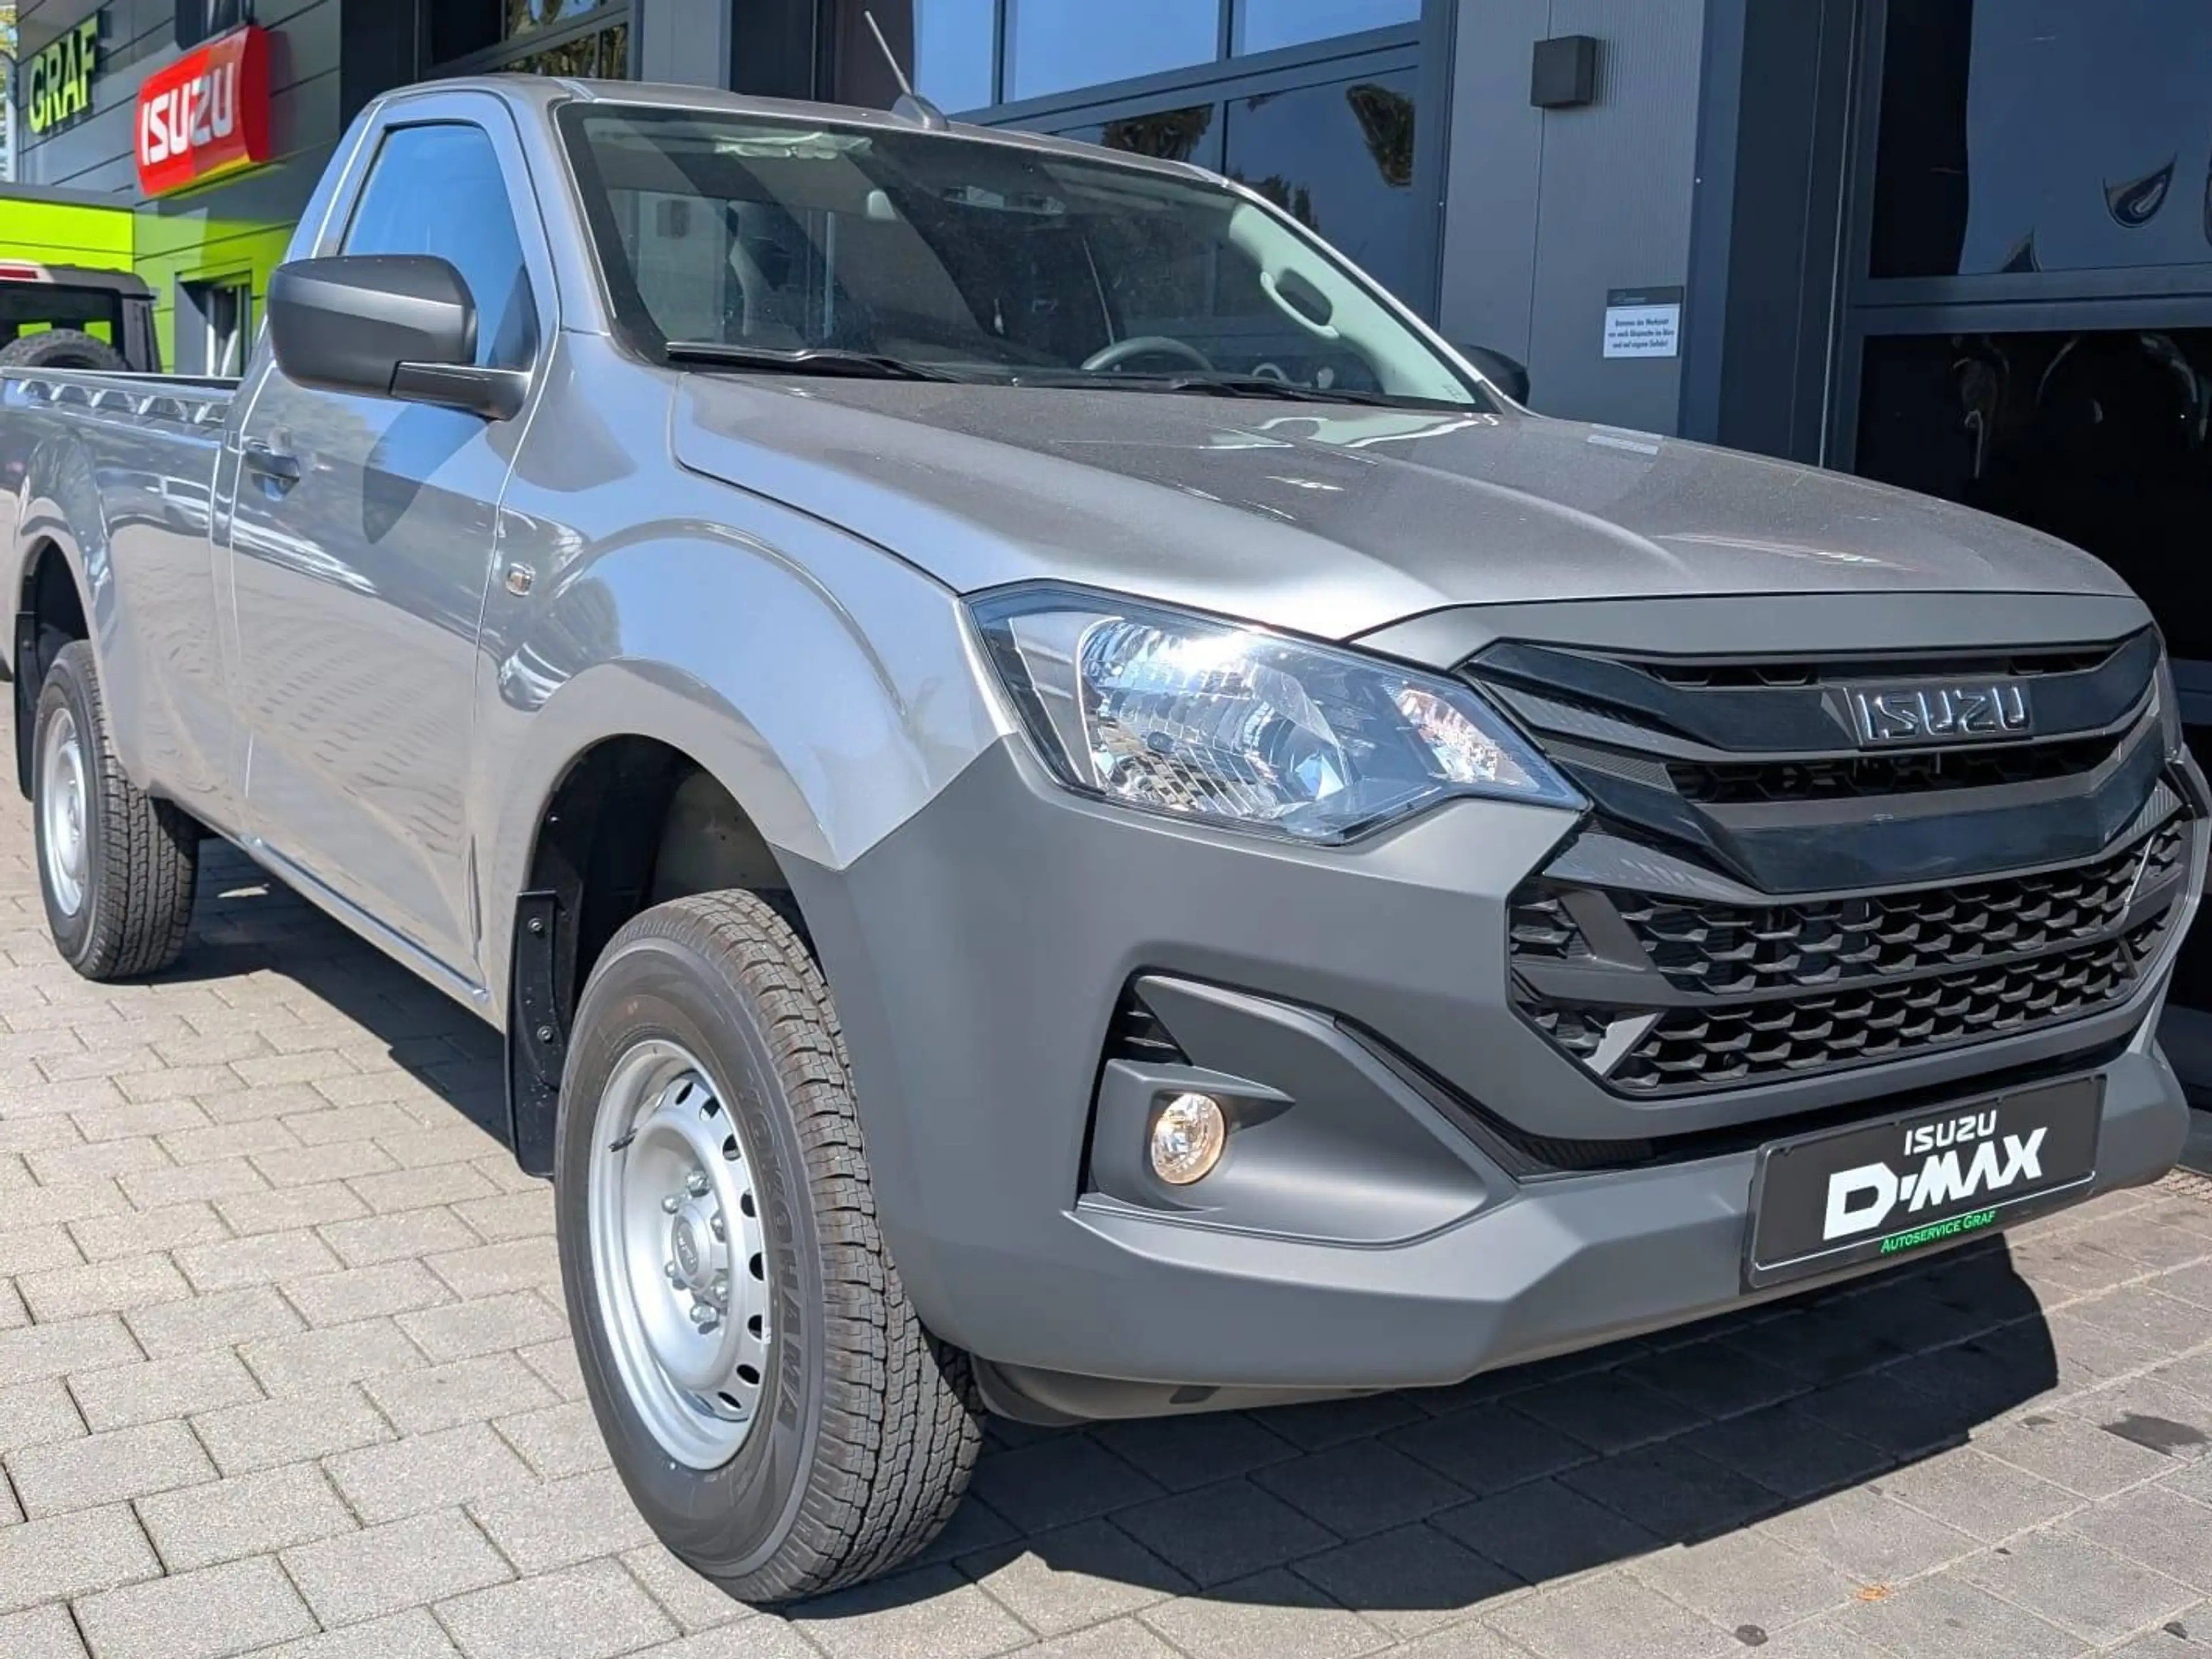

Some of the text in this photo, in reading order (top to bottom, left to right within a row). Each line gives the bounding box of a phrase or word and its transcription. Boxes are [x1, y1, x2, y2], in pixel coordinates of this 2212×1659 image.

[30, 14, 97, 133] GRAF
[141, 62, 234, 166] ISUZU
[1857, 686, 2032, 740] ISUZU
[1823, 1127, 2048, 1241] D-MAX
[1903, 1109, 1997, 1156] ISUZU
